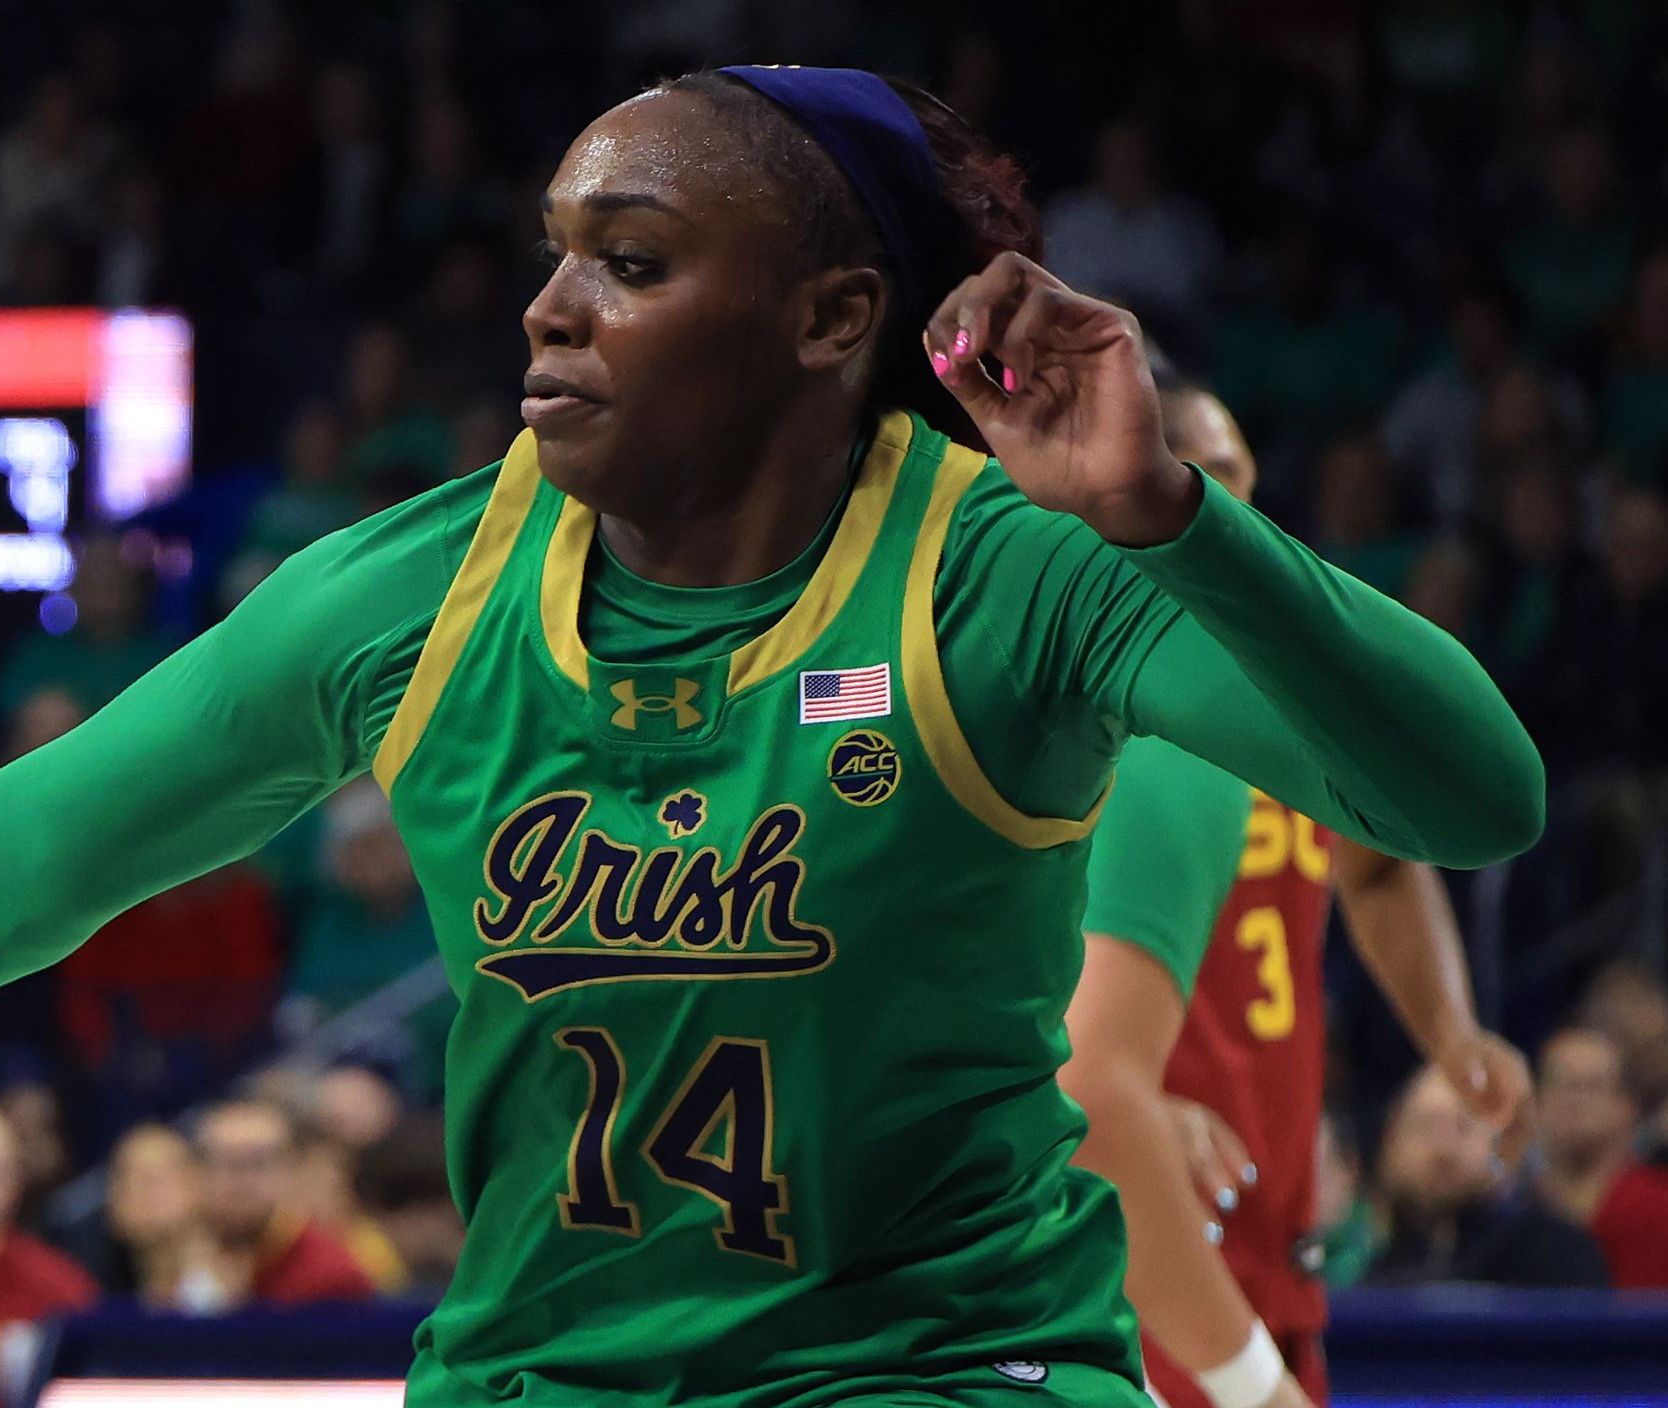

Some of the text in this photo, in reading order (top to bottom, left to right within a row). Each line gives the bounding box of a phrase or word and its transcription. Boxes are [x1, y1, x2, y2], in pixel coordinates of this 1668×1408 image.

[836, 751, 898, 776] ACC
[473, 788, 836, 1003] Irish
[1235, 904, 1298, 1042] 3
[553, 1026, 799, 1268] 14
